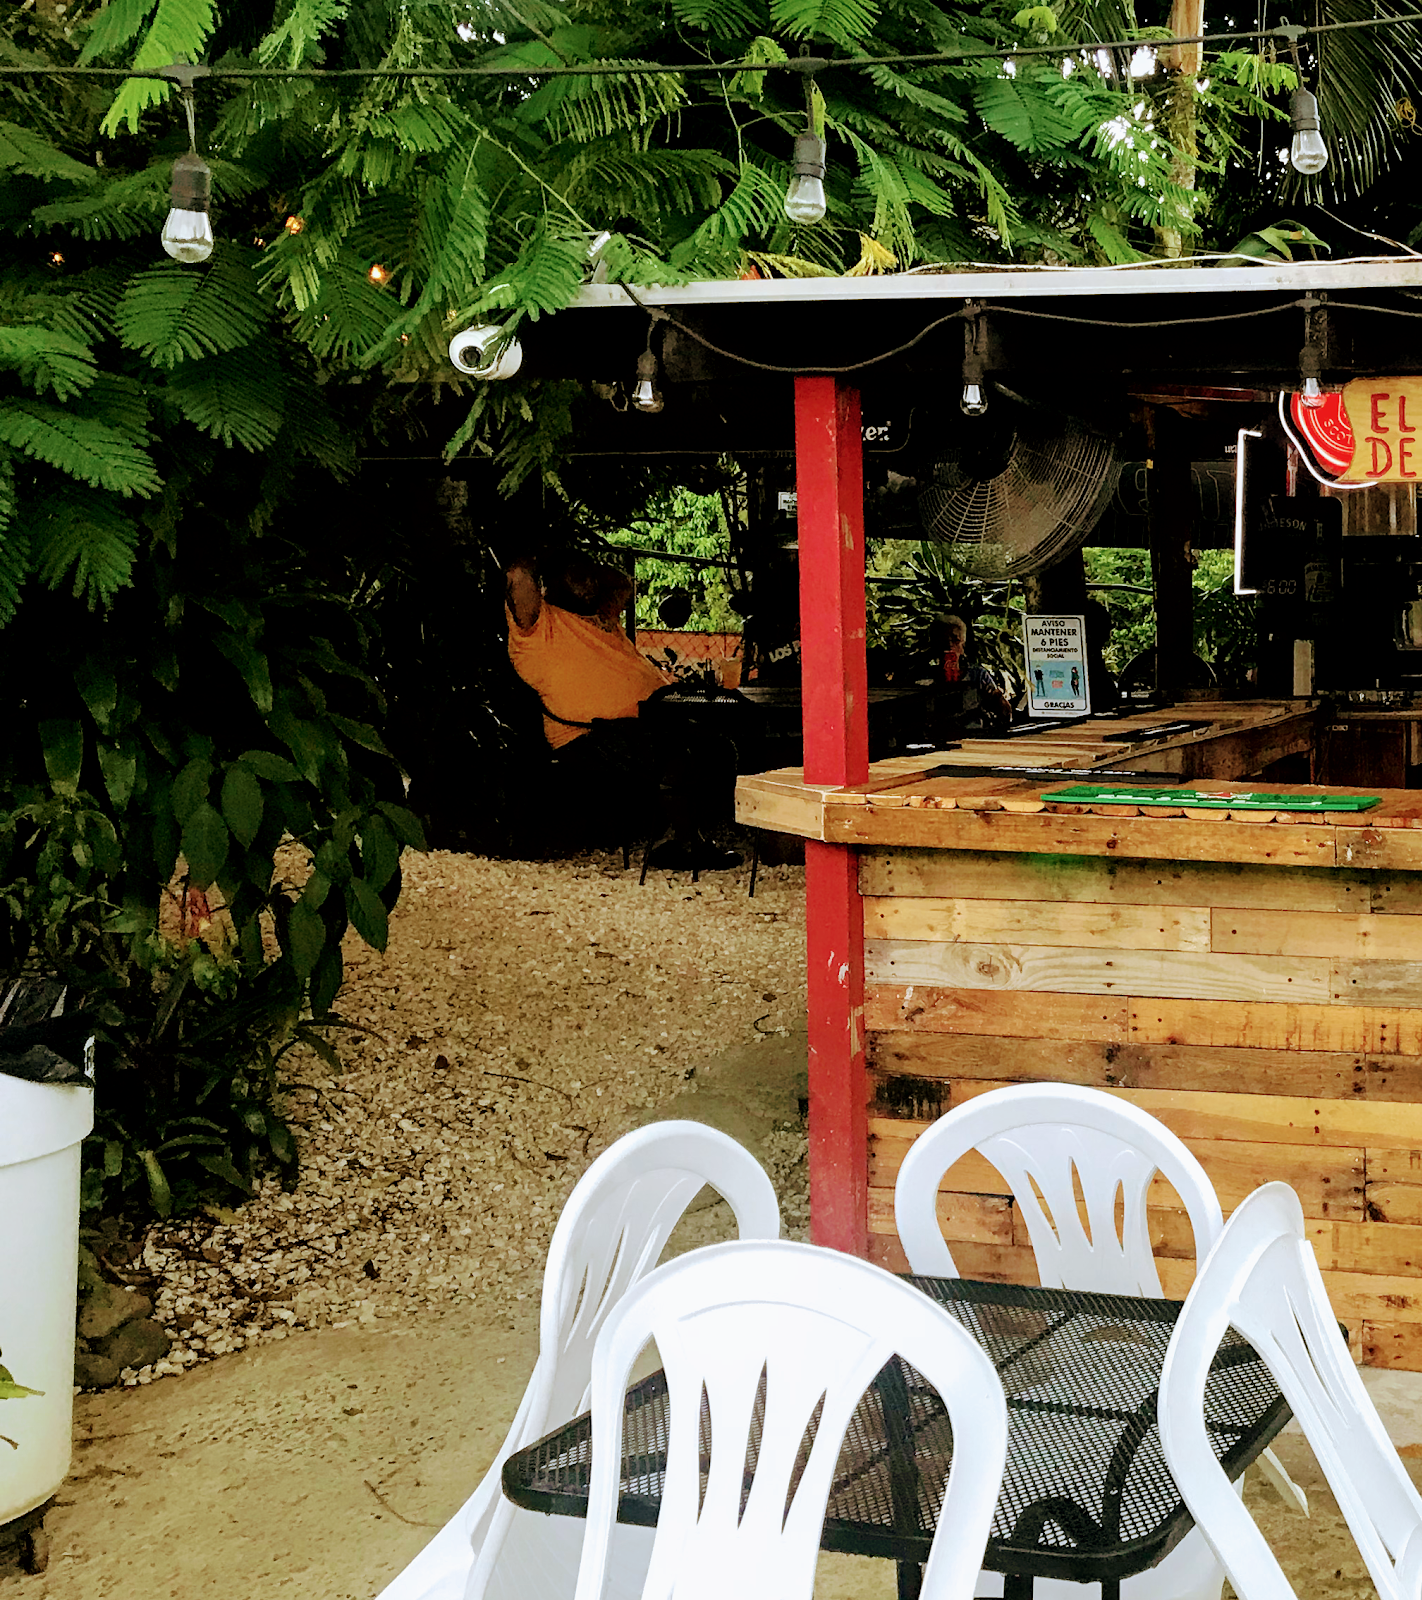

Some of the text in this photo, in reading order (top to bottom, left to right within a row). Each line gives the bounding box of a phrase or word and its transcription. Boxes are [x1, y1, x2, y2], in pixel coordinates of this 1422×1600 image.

[1370, 392, 1417, 433] EL
[1364, 436, 1417, 478] DE
[1030, 628, 1078, 636] MANTENER
[1040, 638, 1069, 647] 6 PIES
[1043, 701, 1075, 709] GRACIAS
